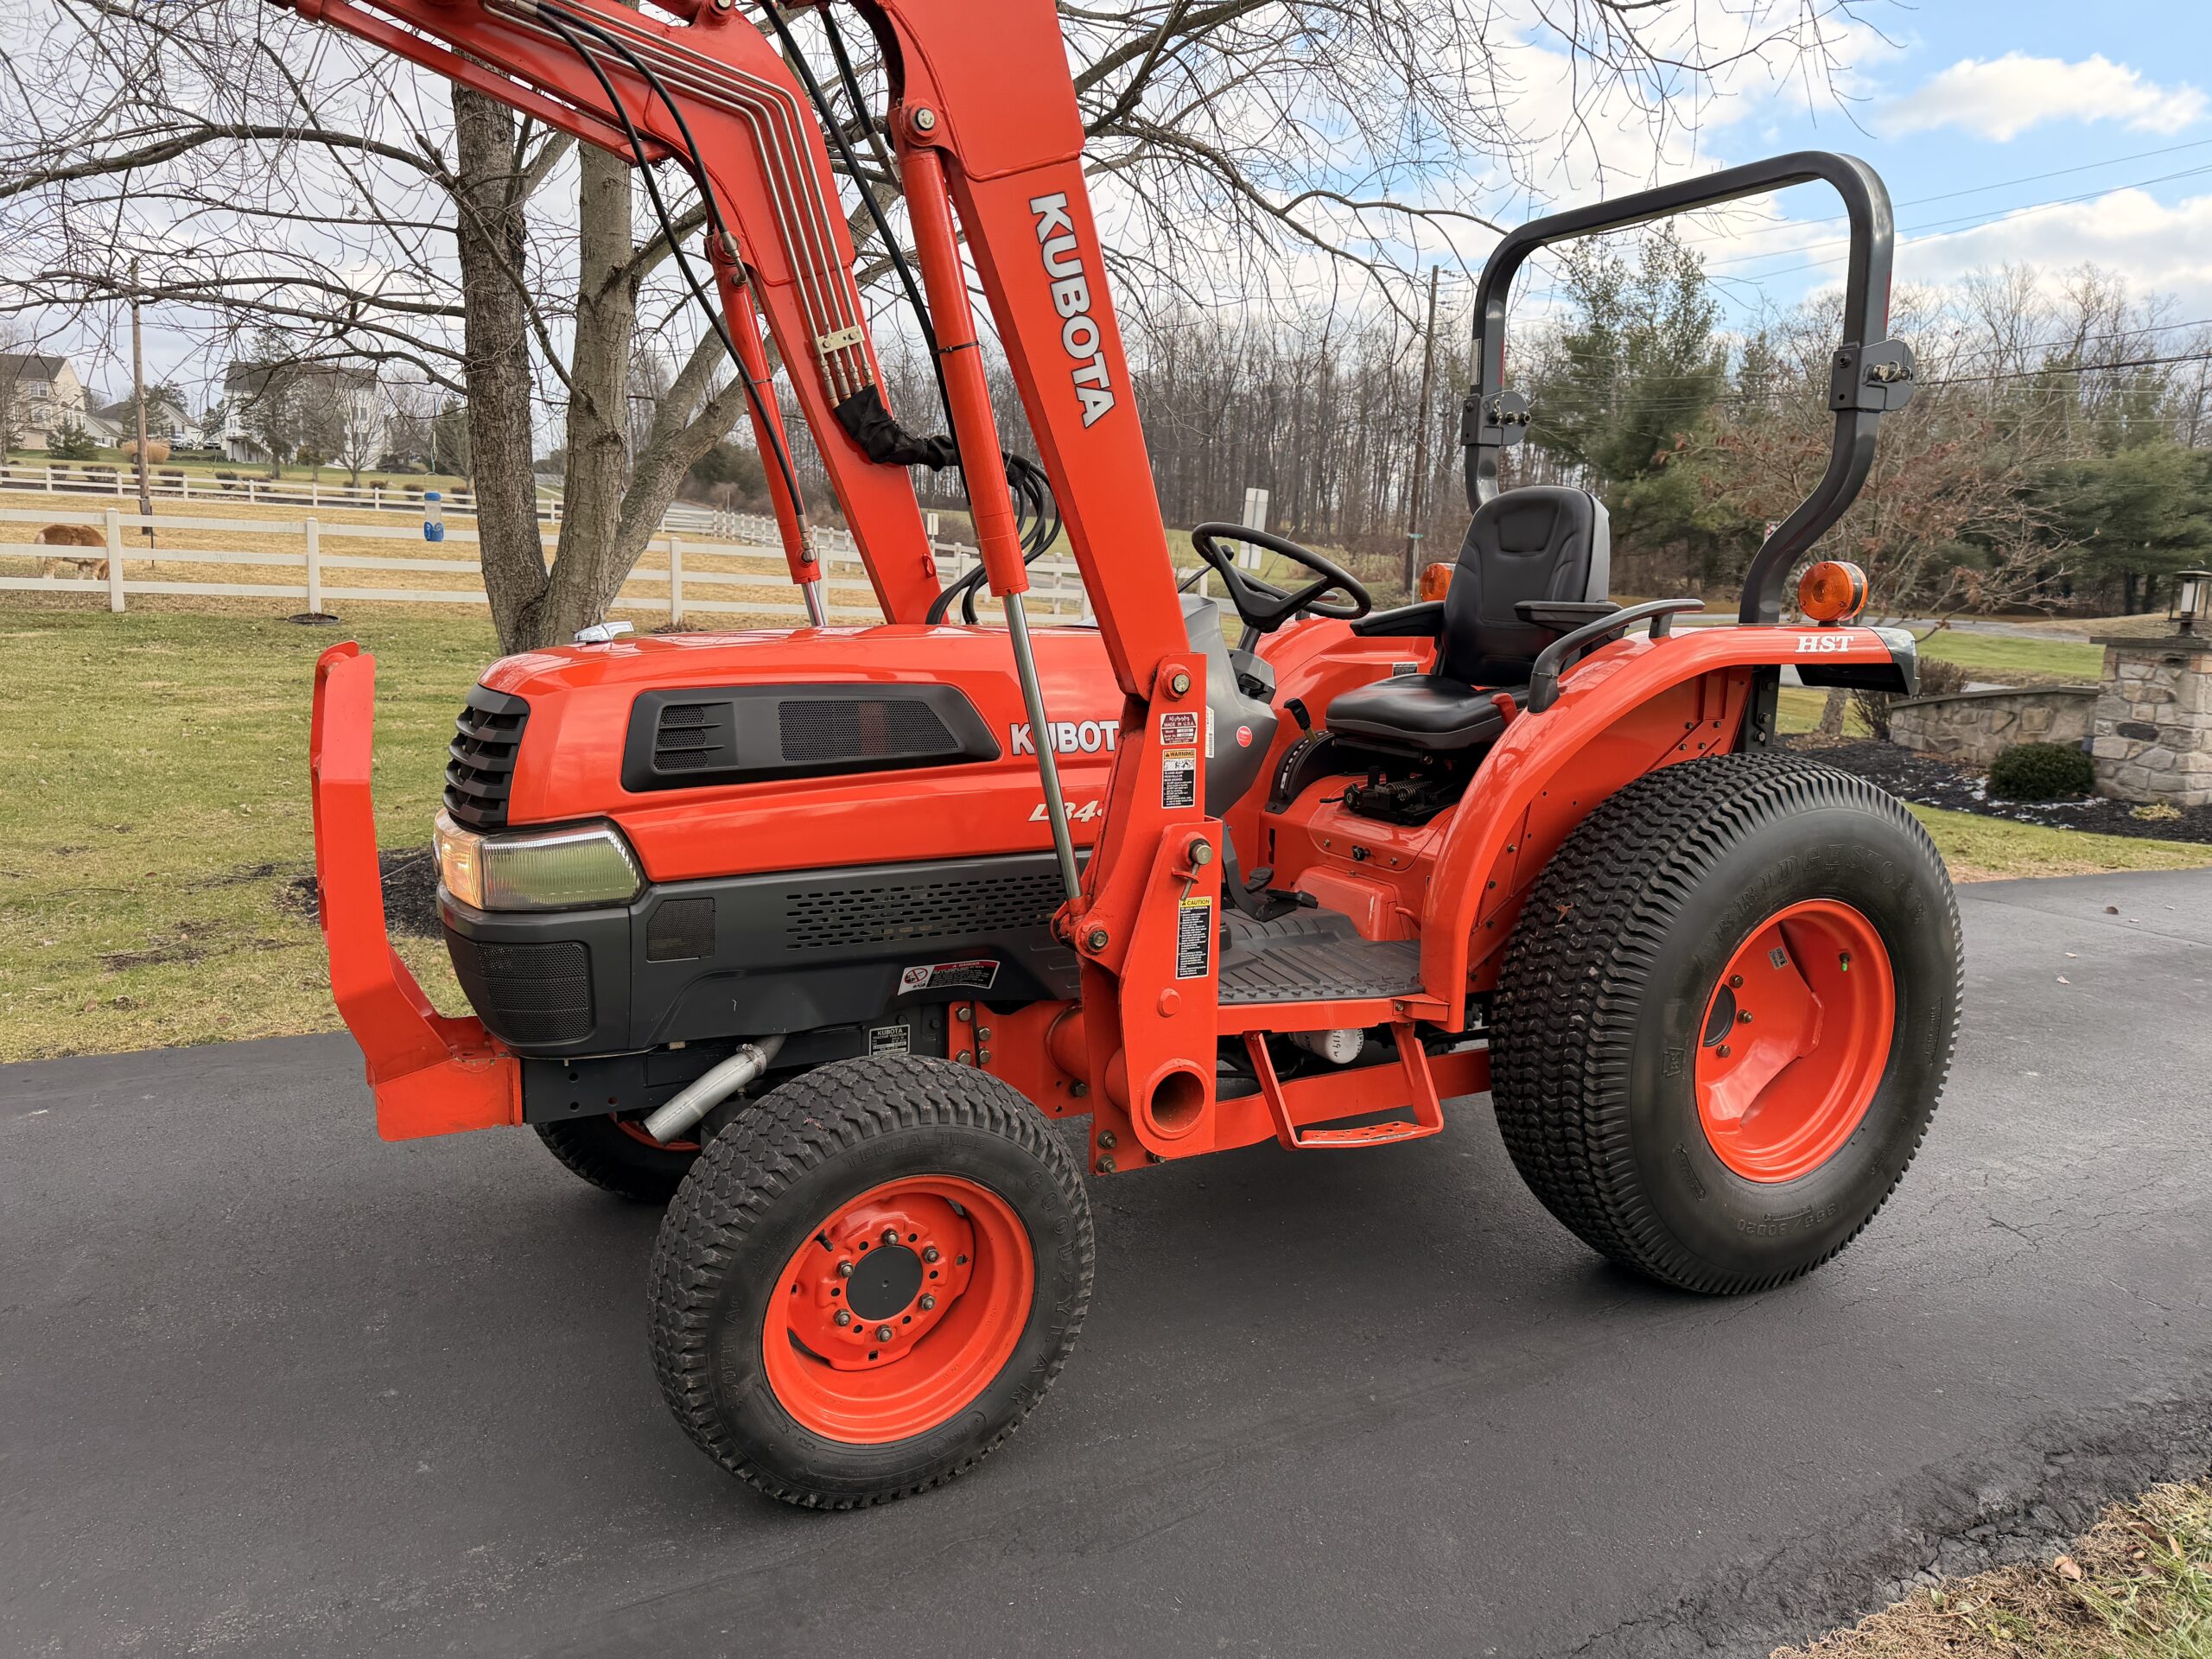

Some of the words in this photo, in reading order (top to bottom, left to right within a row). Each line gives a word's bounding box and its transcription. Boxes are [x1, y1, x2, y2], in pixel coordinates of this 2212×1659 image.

[1029, 191, 1116, 429] KUBOTA
[1795, 635, 1853, 653] HST
[1010, 1169, 1078, 1407] GOODYEAR
